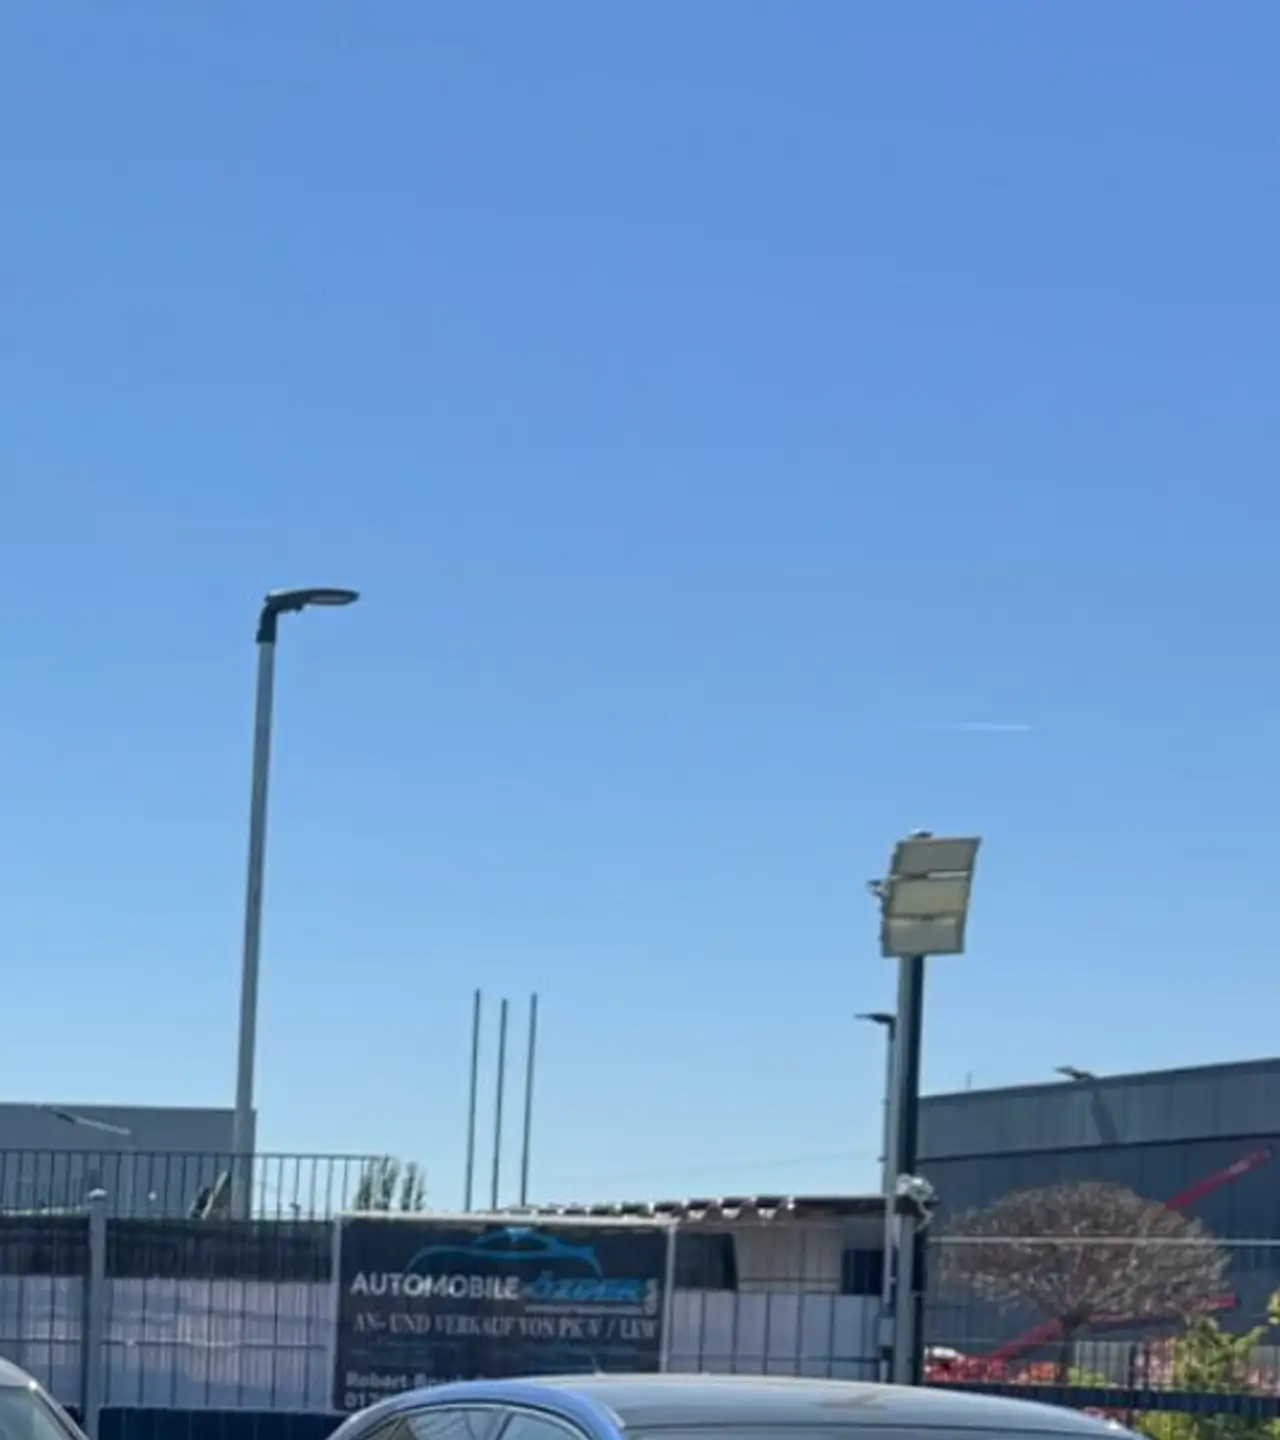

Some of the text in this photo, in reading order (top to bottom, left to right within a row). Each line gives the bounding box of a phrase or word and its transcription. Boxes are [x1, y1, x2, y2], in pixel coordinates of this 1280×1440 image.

[350, 1272, 521, 1300] AUTOMOBILE
[389, 1313, 430, 1335] UND
[434, 1314, 512, 1337] VERKAUF
[345, 1371, 407, 1388] Robert
